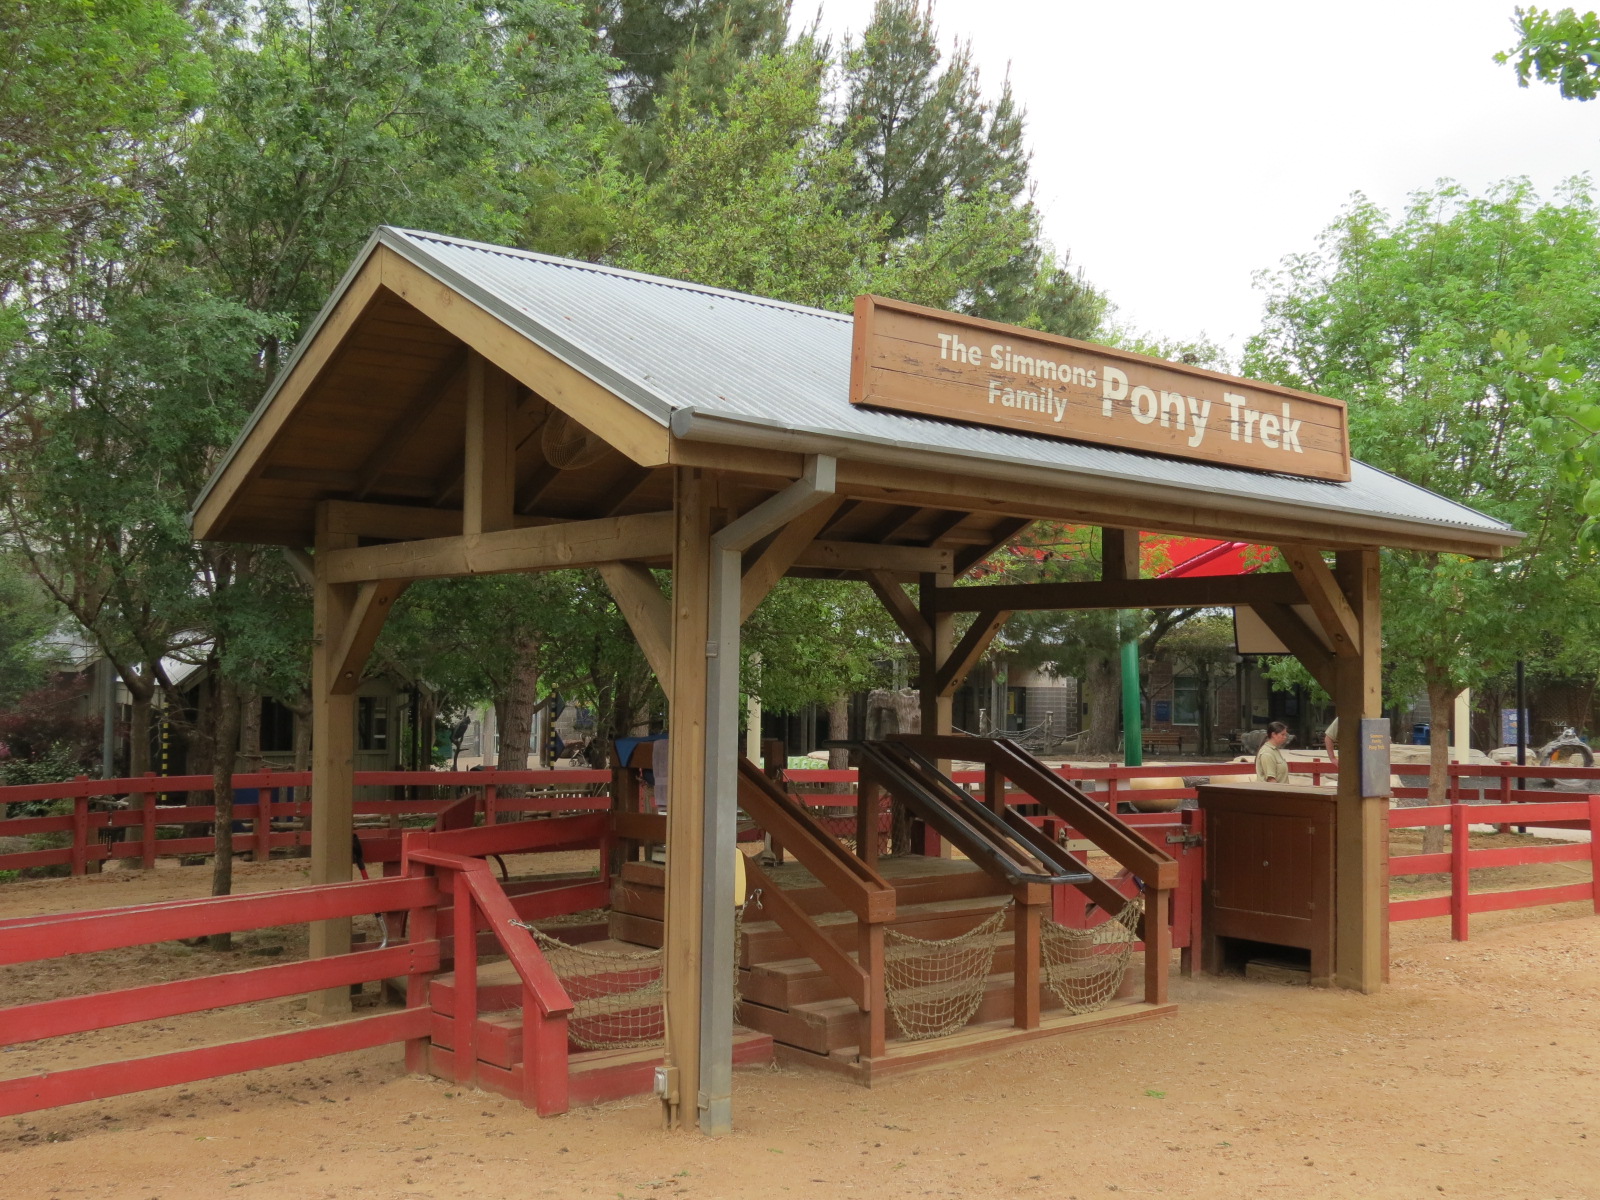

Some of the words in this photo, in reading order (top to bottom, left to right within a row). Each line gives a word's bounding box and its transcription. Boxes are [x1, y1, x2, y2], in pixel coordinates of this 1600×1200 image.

[937, 332, 982, 366] The
[990, 344, 1098, 389] Simmons
[988, 380, 1068, 423] Family
[1102, 366, 1212, 448] Pony
[1224, 392, 1304, 454] Trek
